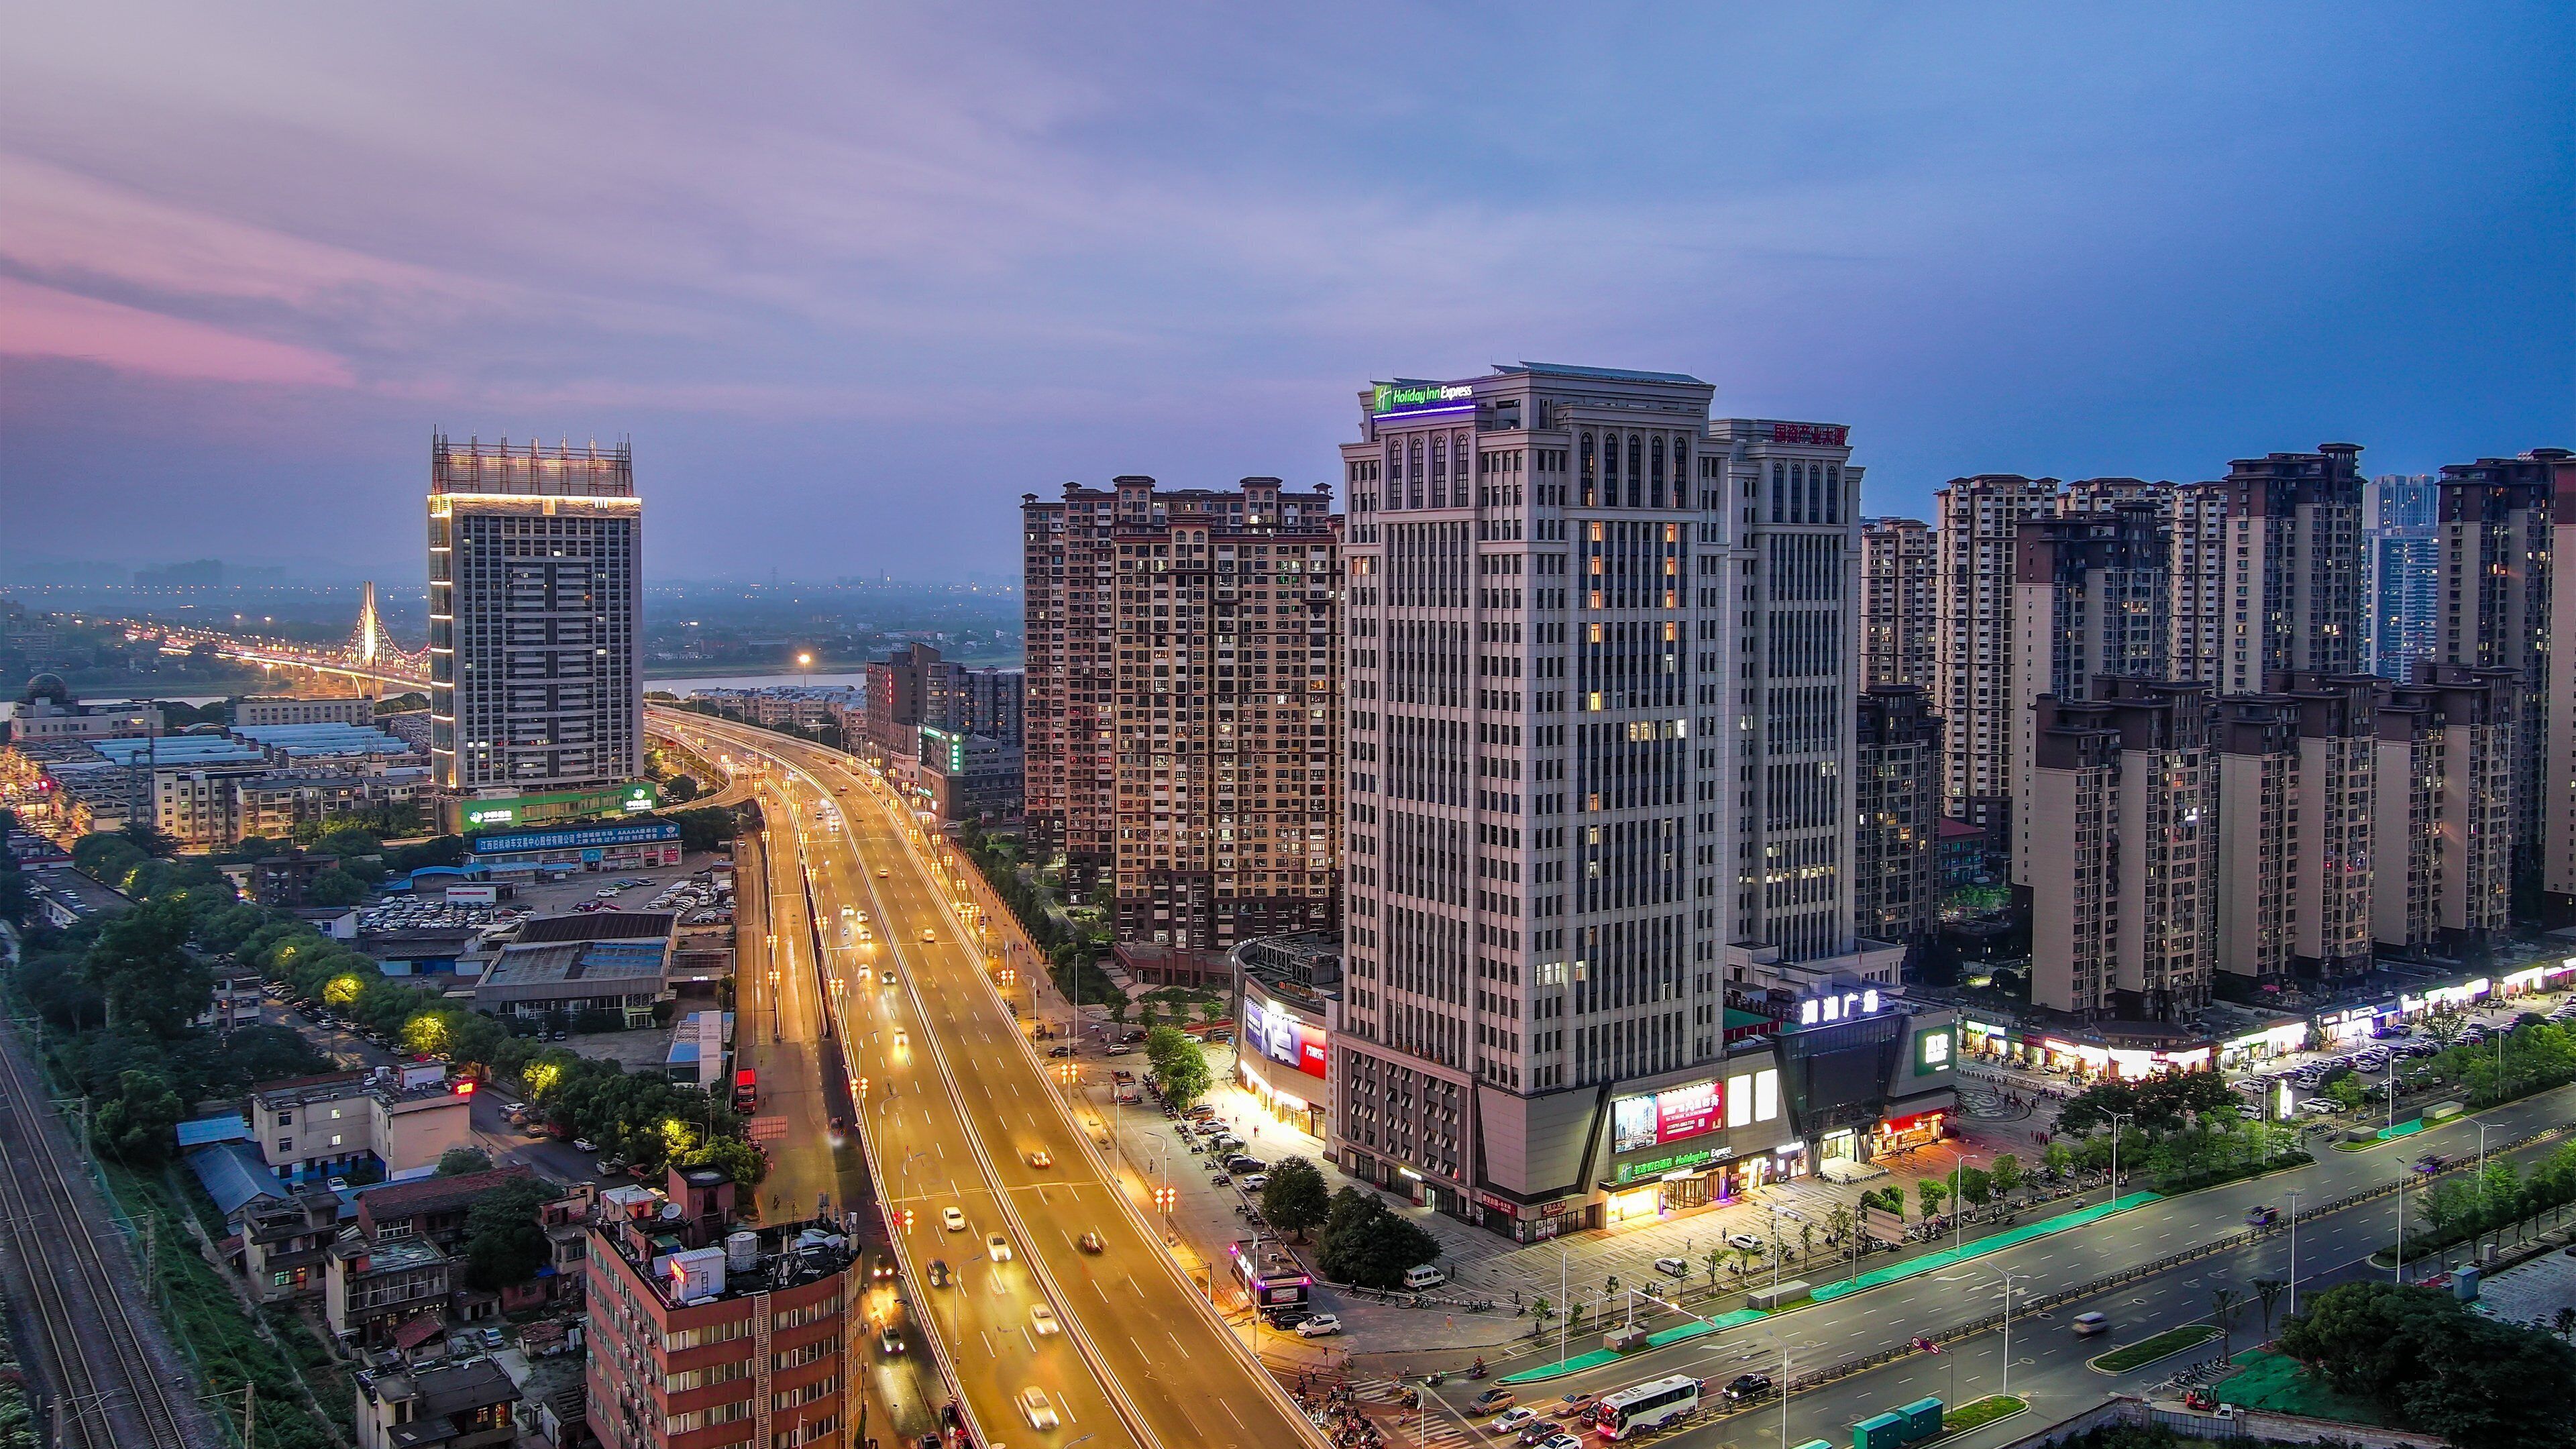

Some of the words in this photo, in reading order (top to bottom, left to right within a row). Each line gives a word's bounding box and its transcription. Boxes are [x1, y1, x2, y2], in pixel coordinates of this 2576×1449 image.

[1394, 388, 1426, 404] Holiday
[1426, 386, 1440, 400] Inn
[1440, 385, 1472, 400] Express
[480, 834, 575, 850] 江西旧机动车交易中心股份有限公司
[1634, 1158, 1673, 1175] 智选假日酒店
[1676, 1152, 1700, 1165] Holiday
[1699, 1150, 1709, 1161] Inn
[1711, 1146, 1732, 1158] Express
